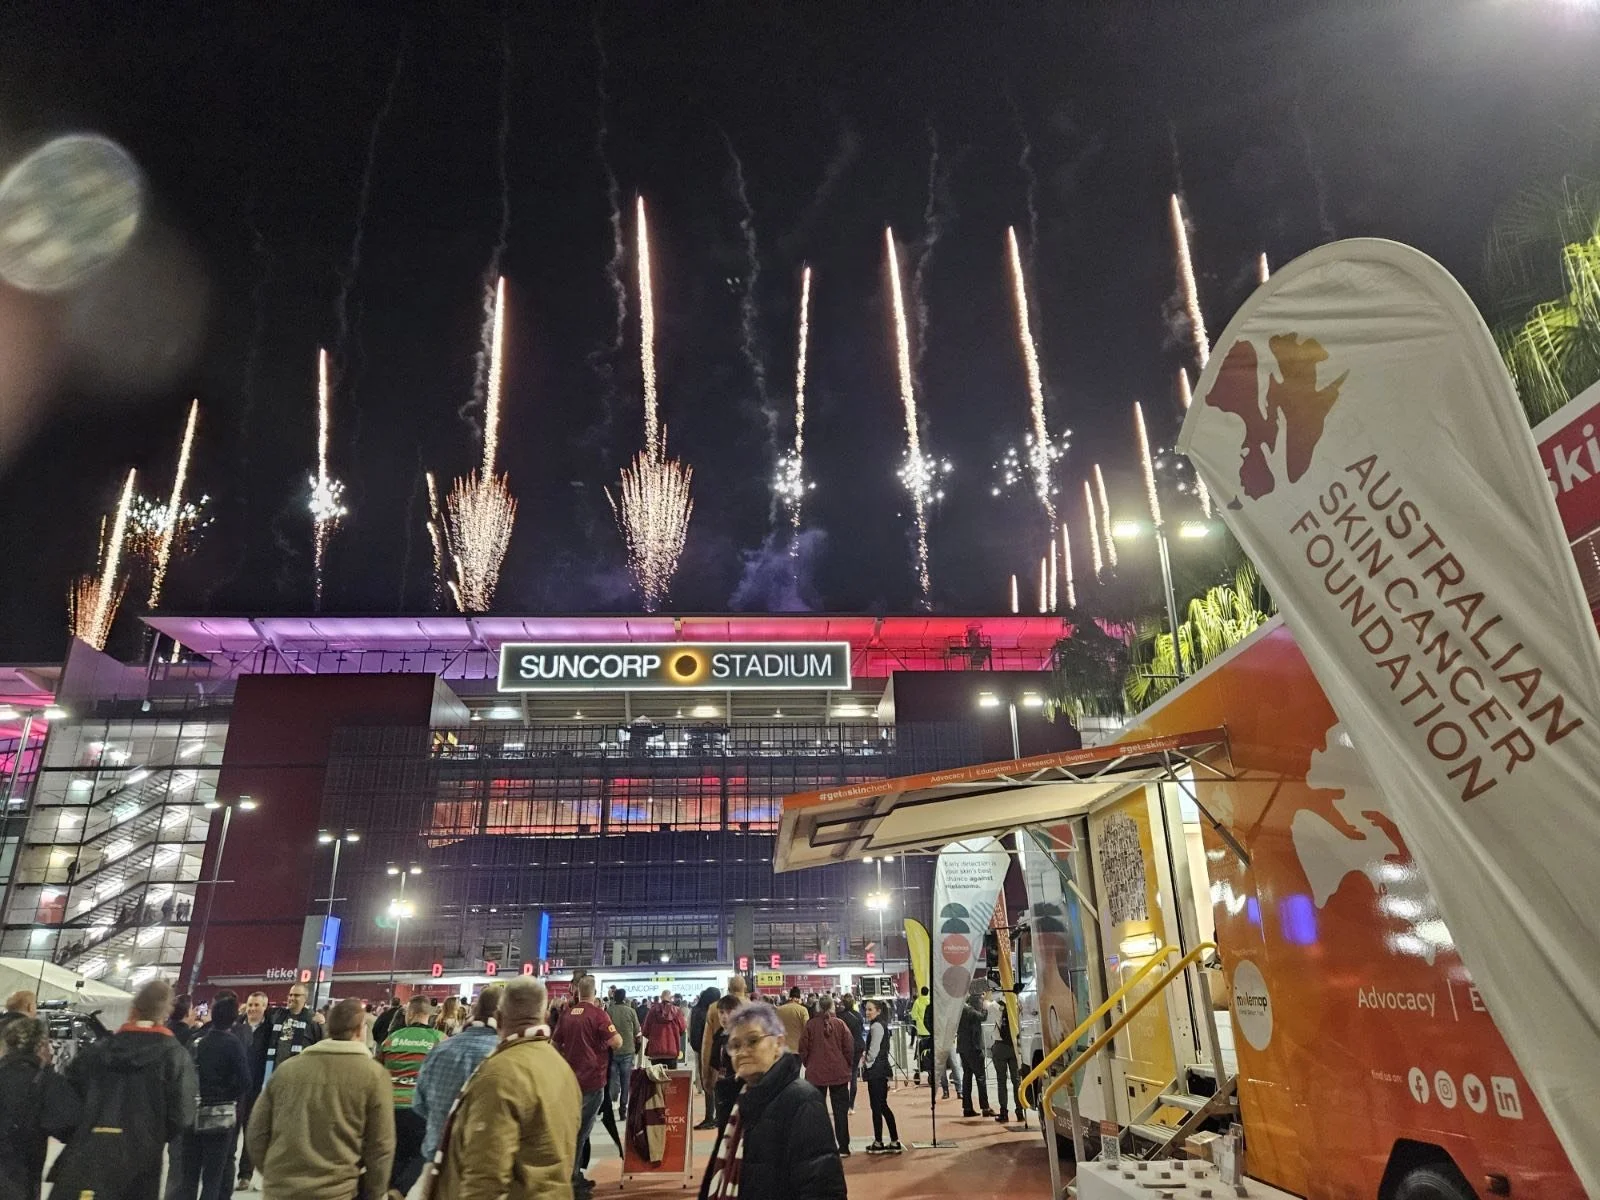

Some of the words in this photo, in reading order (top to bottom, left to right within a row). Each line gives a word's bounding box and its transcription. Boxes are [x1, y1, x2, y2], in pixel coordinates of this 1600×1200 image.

[1345, 453, 1584, 746] AUSTRALIAN
[1319, 481, 1394, 579] SKIN
[1384, 577, 1536, 774] CANCER
[1289, 510, 1498, 802] FOUNDATION
[519, 654, 661, 679] SUNCORP
[711, 653, 832, 678] STADIUM
[819, 782, 893, 801] #getaskincheck
[930, 771, 965, 784] Advocacy
[975, 763, 1012, 776] Education
[1022, 757, 1055, 768] Research
[1065, 751, 1094, 762] Support
[739, 957, 748, 971] E
[771, 954, 780, 969] E
[818, 953, 827, 968] E
[866, 952, 876, 967] E
[266, 967, 298, 979] ticket
[301, 969, 311, 983] D
[431, 963, 443, 977] D
[523, 963, 533, 976] D
[1358, 985, 1436, 1018] Advocacy
[1496, 1082, 1519, 1113] in
